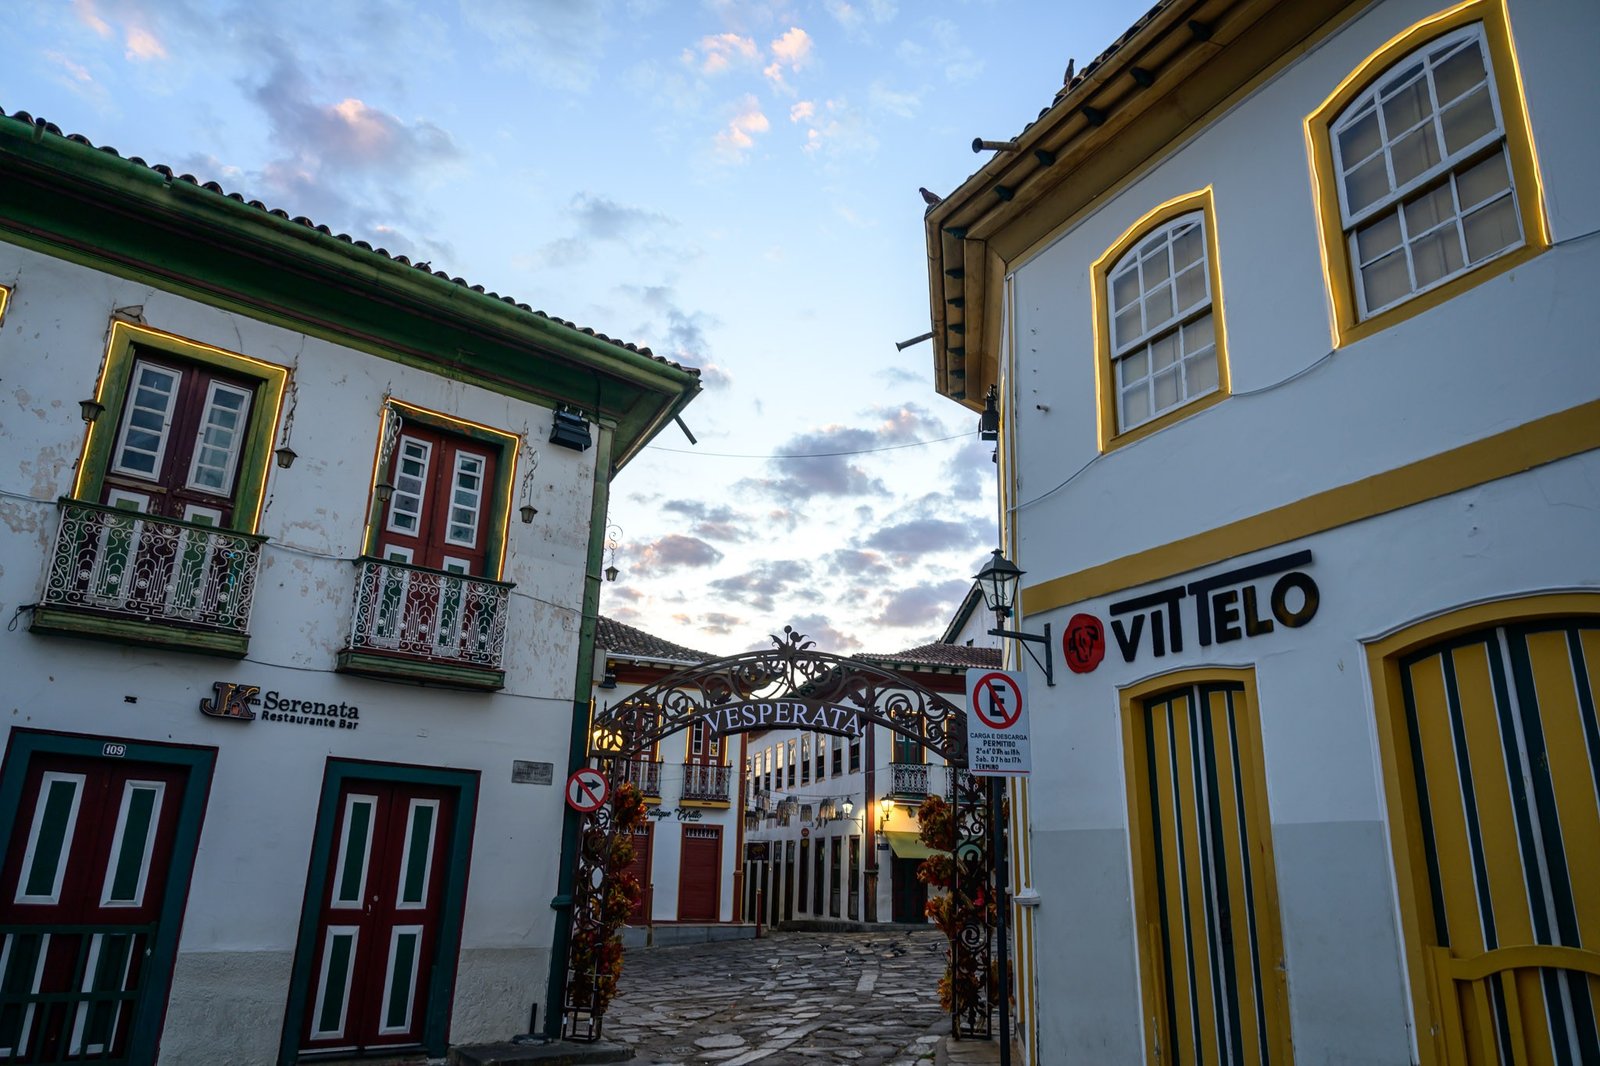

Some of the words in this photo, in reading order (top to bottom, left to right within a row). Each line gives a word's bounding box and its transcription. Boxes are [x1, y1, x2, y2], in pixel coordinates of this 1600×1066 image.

[1109, 549, 1320, 663] VITTELO
[263, 690, 360, 719] Serenata
[261, 711, 336, 727] Restaurante
[338, 718, 359, 730] Bar
[703, 702, 861, 736] VESPERATA
[982, 740, 1016, 748] PERMITIDO
[996, 733, 1028, 741] DESCARGA
[106, 745, 124, 755] 109
